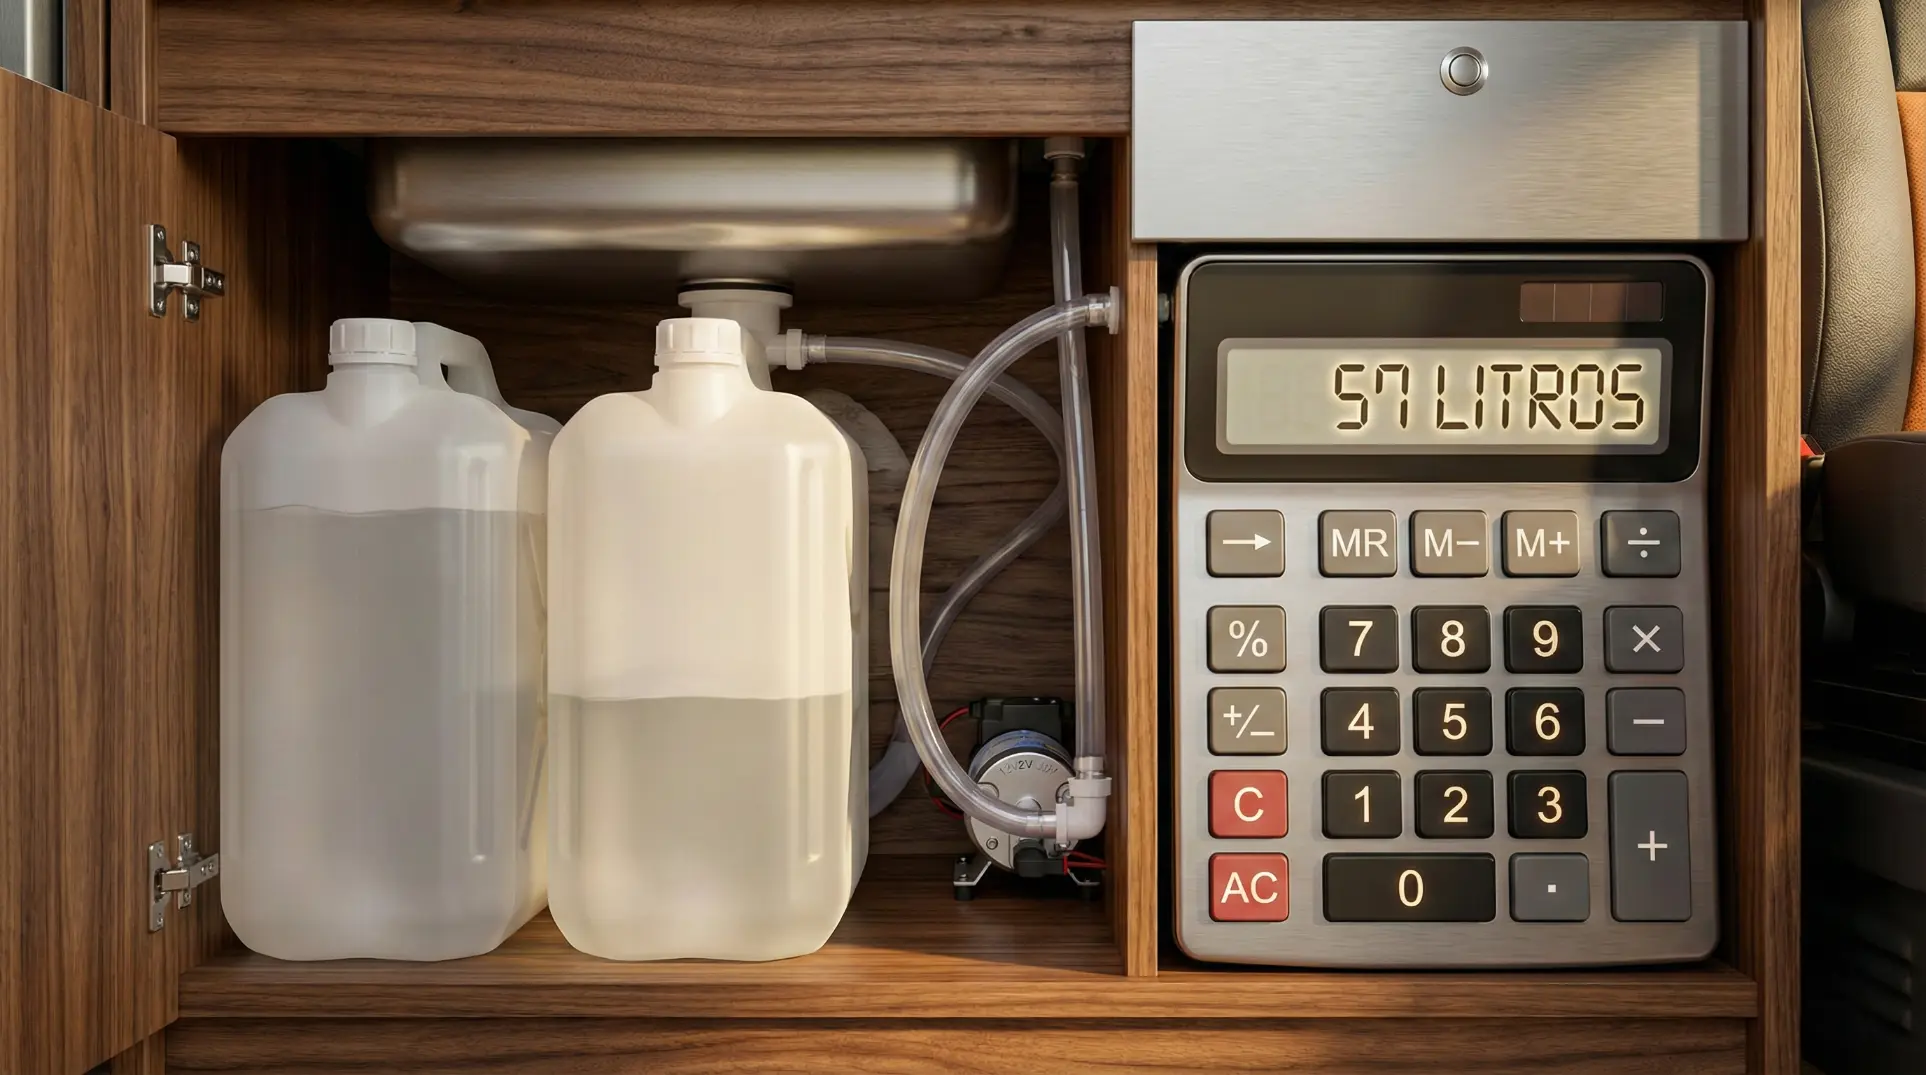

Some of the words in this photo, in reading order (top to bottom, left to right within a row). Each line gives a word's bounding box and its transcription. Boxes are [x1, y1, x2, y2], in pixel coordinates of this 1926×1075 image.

[1335, 364, 1409, 430] 57
[1436, 364, 1644, 430] LITROS
[1332, 528, 1389, 557] MR
[1516, 528, 1571, 557] M+
[1348, 620, 1374, 657] 7
[1440, 619, 1466, 658] 8
[1533, 620, 1559, 658] 9
[1347, 702, 1375, 740] 4
[1442, 703, 1467, 740] 5
[1535, 702, 1561, 741] 6
[1234, 786, 1264, 822] C
[1354, 785, 1371, 823] 1
[1443, 786, 1469, 823] 2
[1537, 786, 1563, 823] 3
[1220, 871, 1278, 904] AC
[1398, 869, 1424, 907] 0
